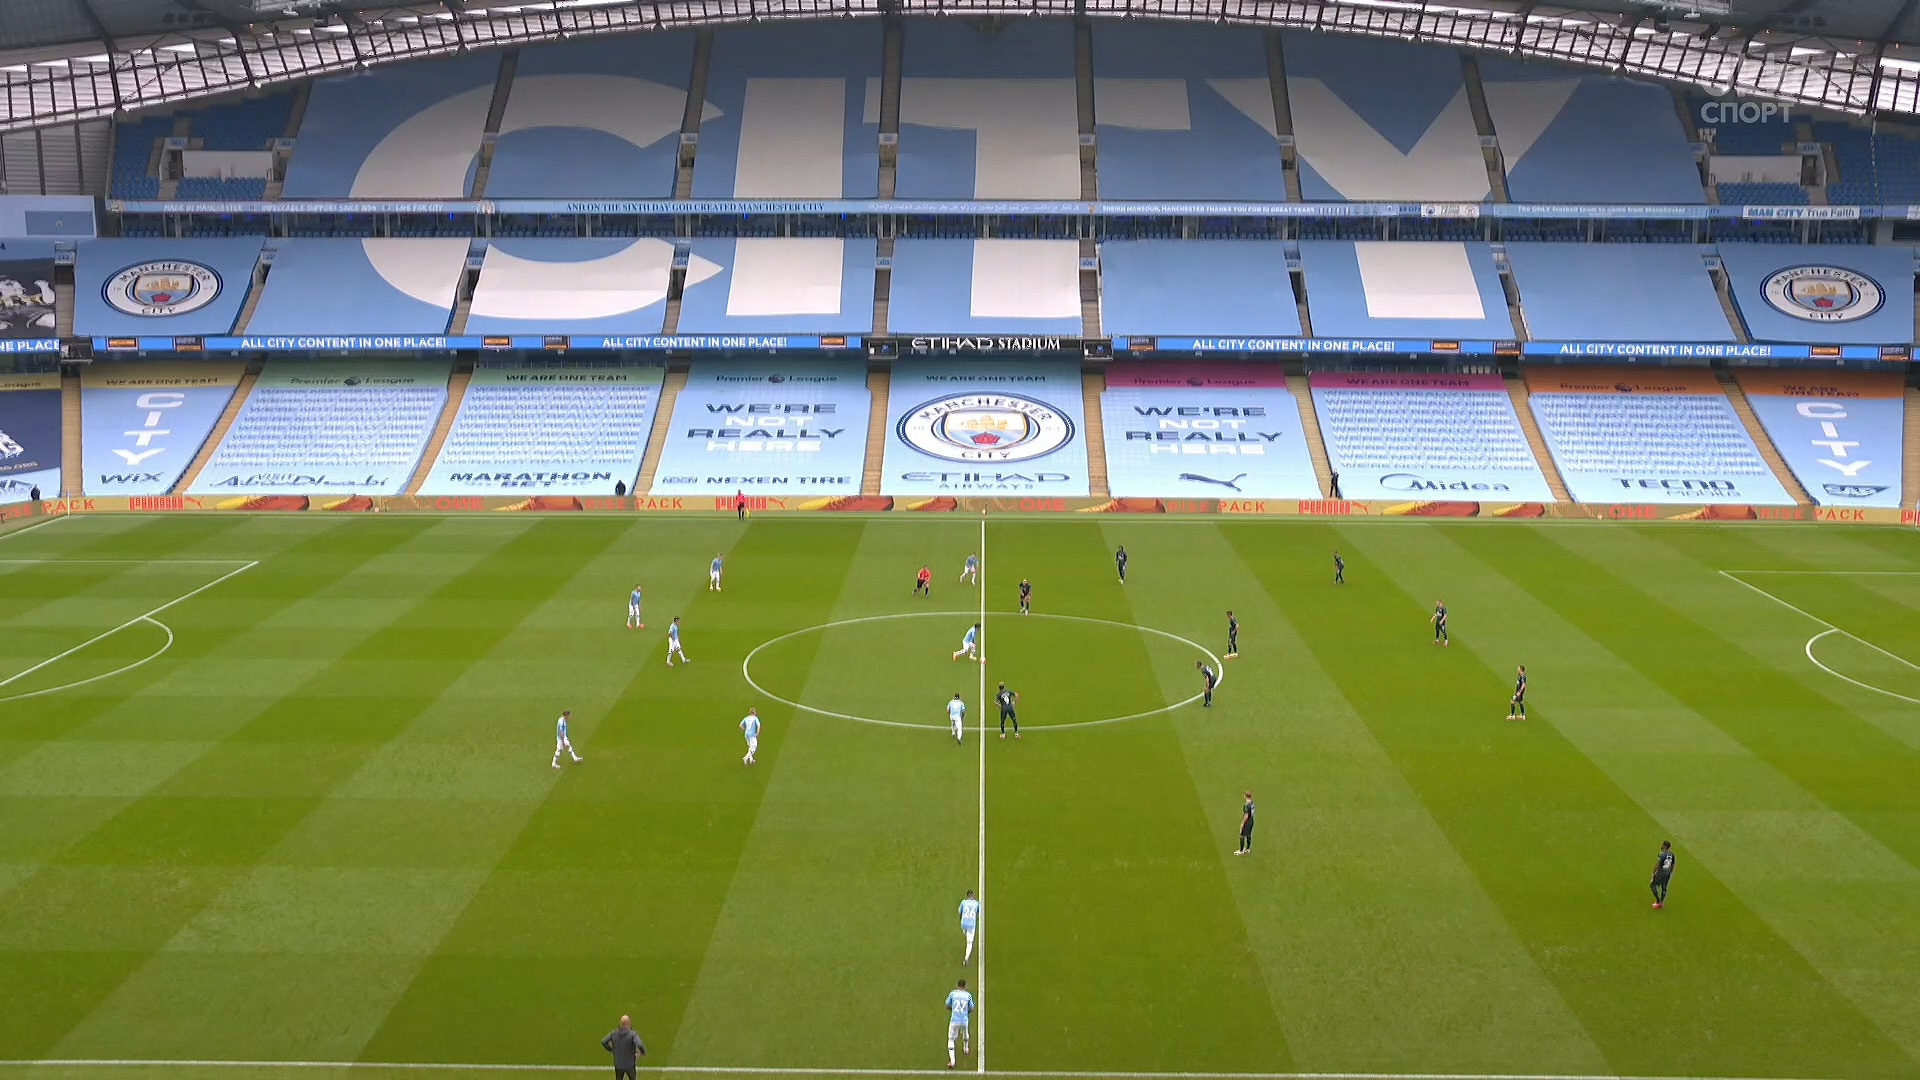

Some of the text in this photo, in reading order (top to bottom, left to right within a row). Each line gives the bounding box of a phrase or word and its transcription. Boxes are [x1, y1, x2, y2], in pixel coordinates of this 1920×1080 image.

[1748, 208, 1855, 218] MAN CITY True Faith
[119, 262, 211, 282] MANCHESTER
[1773, 267, 1869, 288] MANCHESTER
[141, 307, 176, 315] CITY
[1809, 311, 1844, 320] CITY
[241, 337, 447, 348] ALL CITY CONTENT IN ONE PLACE!
[602, 337, 787, 348] ALL CITY CONTENT IN ONE PLACE!
[911, 338, 1061, 350] ETIHAD STADIUM
[1192, 339, 1395, 352] ALL CITY CONTENT IN ONE PLACE!
[1560, 343, 1771, 358] ALL CITY CONTENT IN ONE PLACE!
[705, 403, 837, 414] WE'RE
[918, 397, 1053, 421] MANCHESTER
[1133, 406, 1267, 417] WE'RE
[725, 416, 814, 427] NOT
[1159, 419, 1247, 429] NOT
[112, 392, 185, 466] CITY
[687, 428, 846, 438] REALLY
[1125, 431, 1283, 442] REALLY
[1796, 402, 1872, 477] CITY
[705, 440, 823, 452] HERE
[1149, 443, 1266, 455] HERE
[962, 451, 1010, 459] CITY
[101, 471, 164, 484] WIX
[450, 471, 612, 481] MARATHON
[706, 476, 789, 485] NEXEN
[796, 476, 852, 485] TIRE
[901, 472, 1071, 482] ETIHAD
[1410, 480, 1511, 491] Midea
[1611, 478, 1736, 490] TECNO
[42, 498, 96, 514] PACK
[636, 497, 683, 510] PACK
[1218, 500, 1266, 513] PACK
[1298, 499, 1351, 514] PUMA
[1814, 508, 1865, 521] PACK
